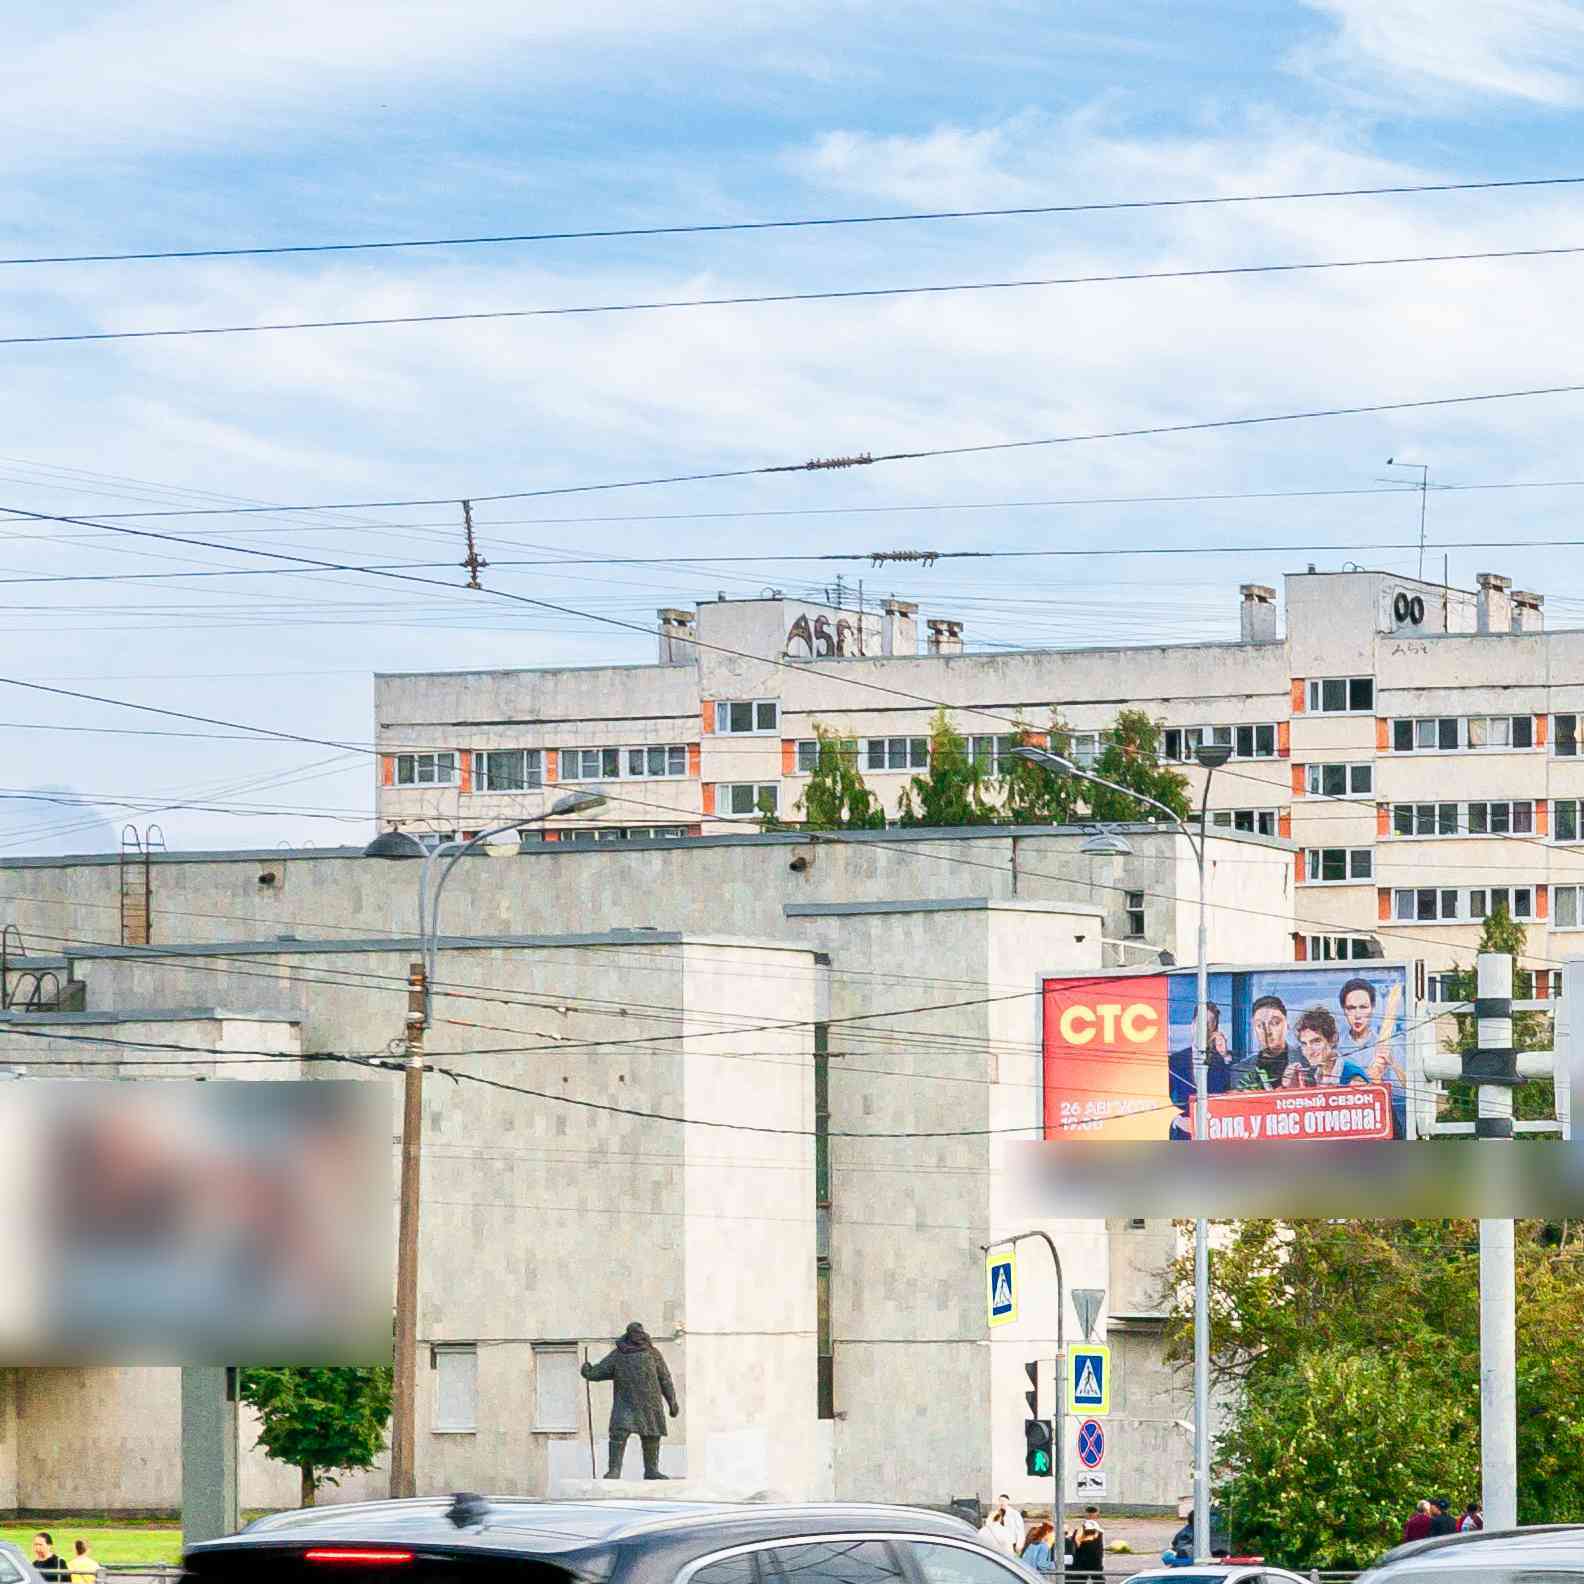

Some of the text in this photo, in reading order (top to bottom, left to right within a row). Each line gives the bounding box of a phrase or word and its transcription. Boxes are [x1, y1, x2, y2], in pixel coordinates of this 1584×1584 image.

[1060, 1003, 1158, 1044] СТС
[1207, 1114, 1249, 1139] аля,
[1266, 1112, 1300, 1136] нас
[1304, 1101, 1382, 1133] отмена!
[1276, 1094, 1374, 1109] НОВЫЙ СЕЗОН
